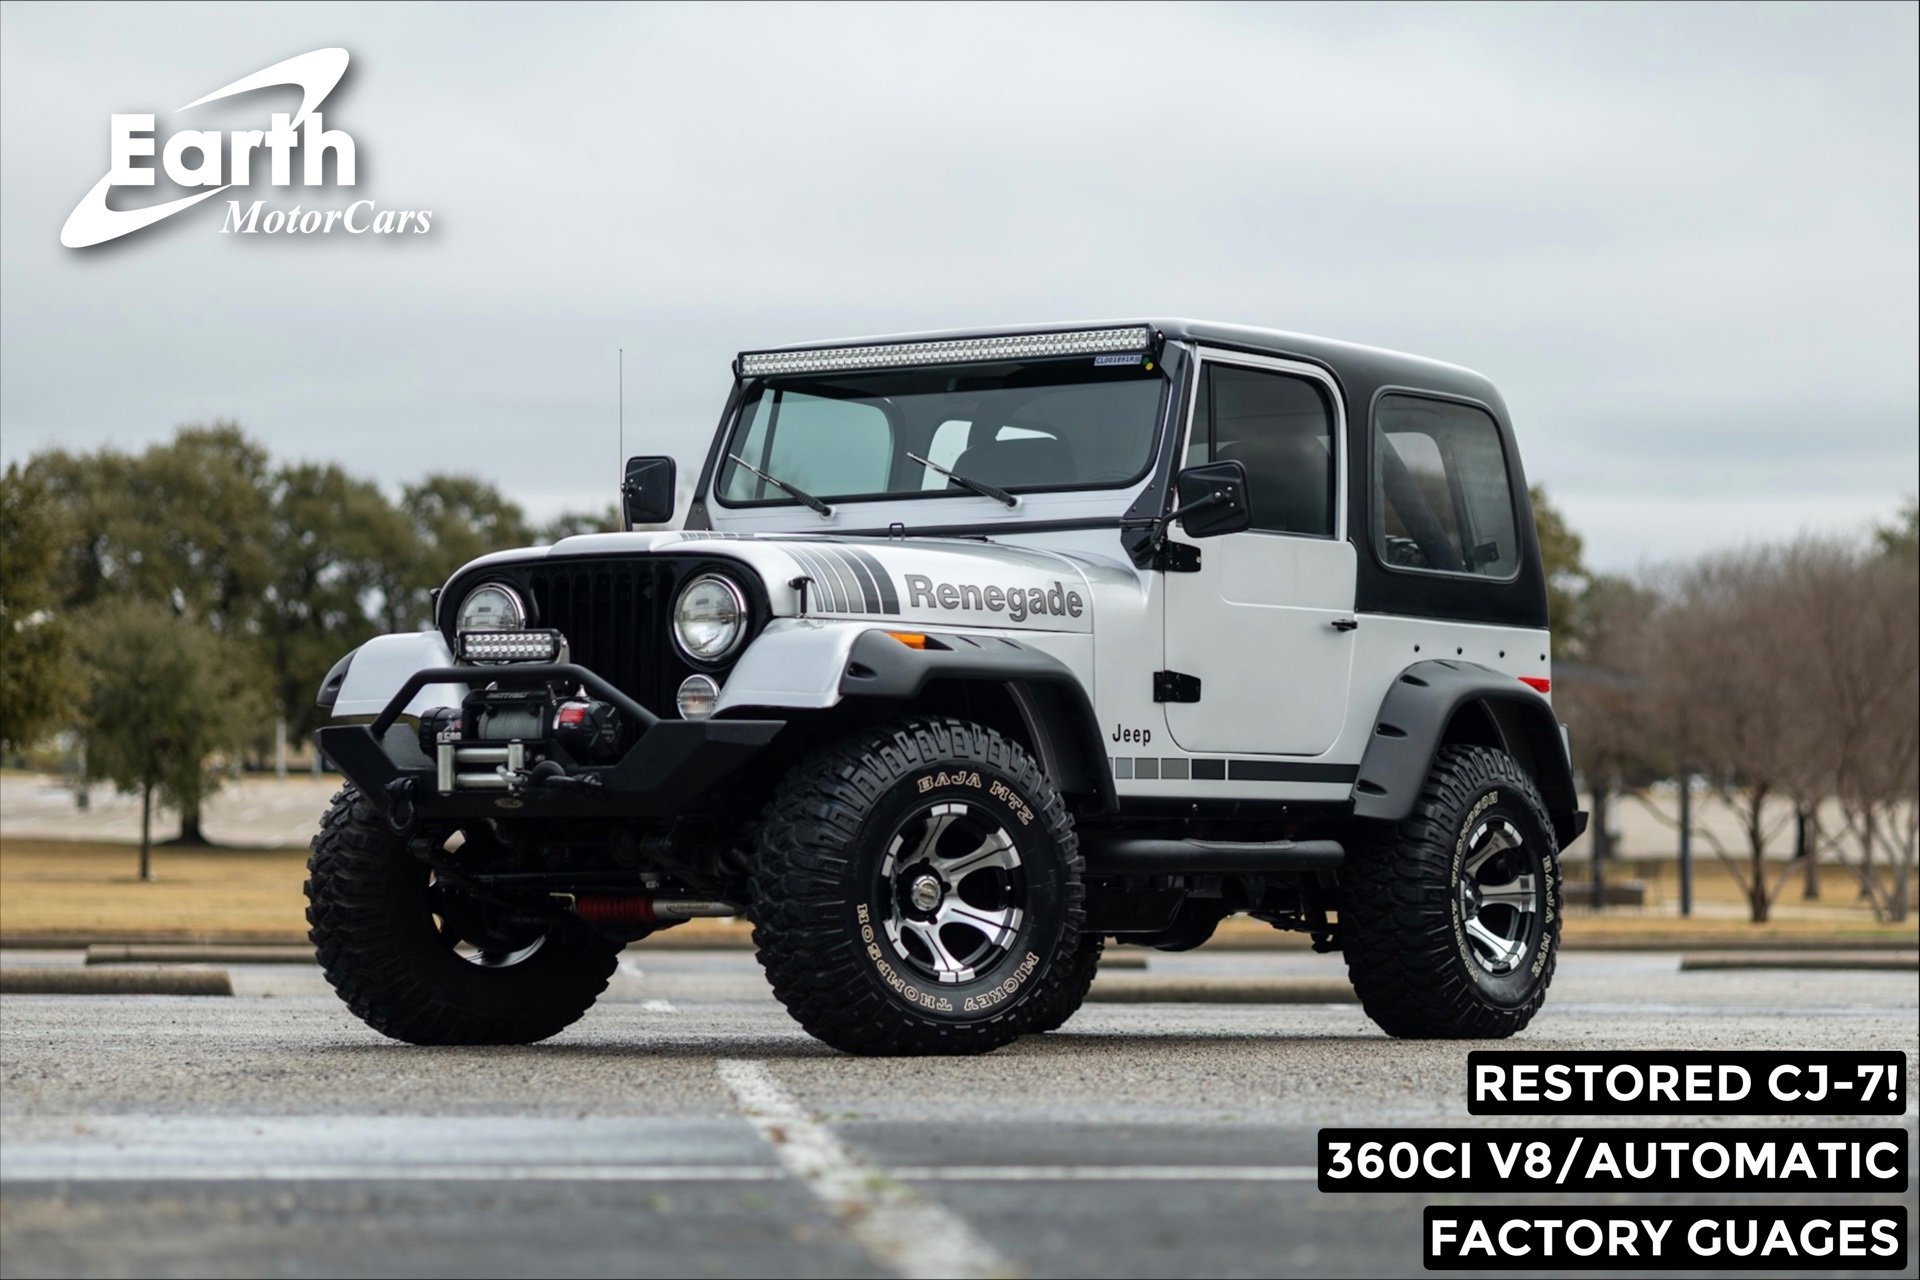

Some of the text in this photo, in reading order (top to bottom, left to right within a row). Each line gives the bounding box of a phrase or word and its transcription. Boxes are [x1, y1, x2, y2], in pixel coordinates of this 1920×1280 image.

[904, 574, 1083, 622] Renegade
[1112, 724, 1151, 746] Jeep
[917, 771, 1035, 826] BAJA MTZ
[1531, 855, 1555, 979] BAJA MTZ
[857, 903, 1040, 1011] MICKEY THOMPSON
